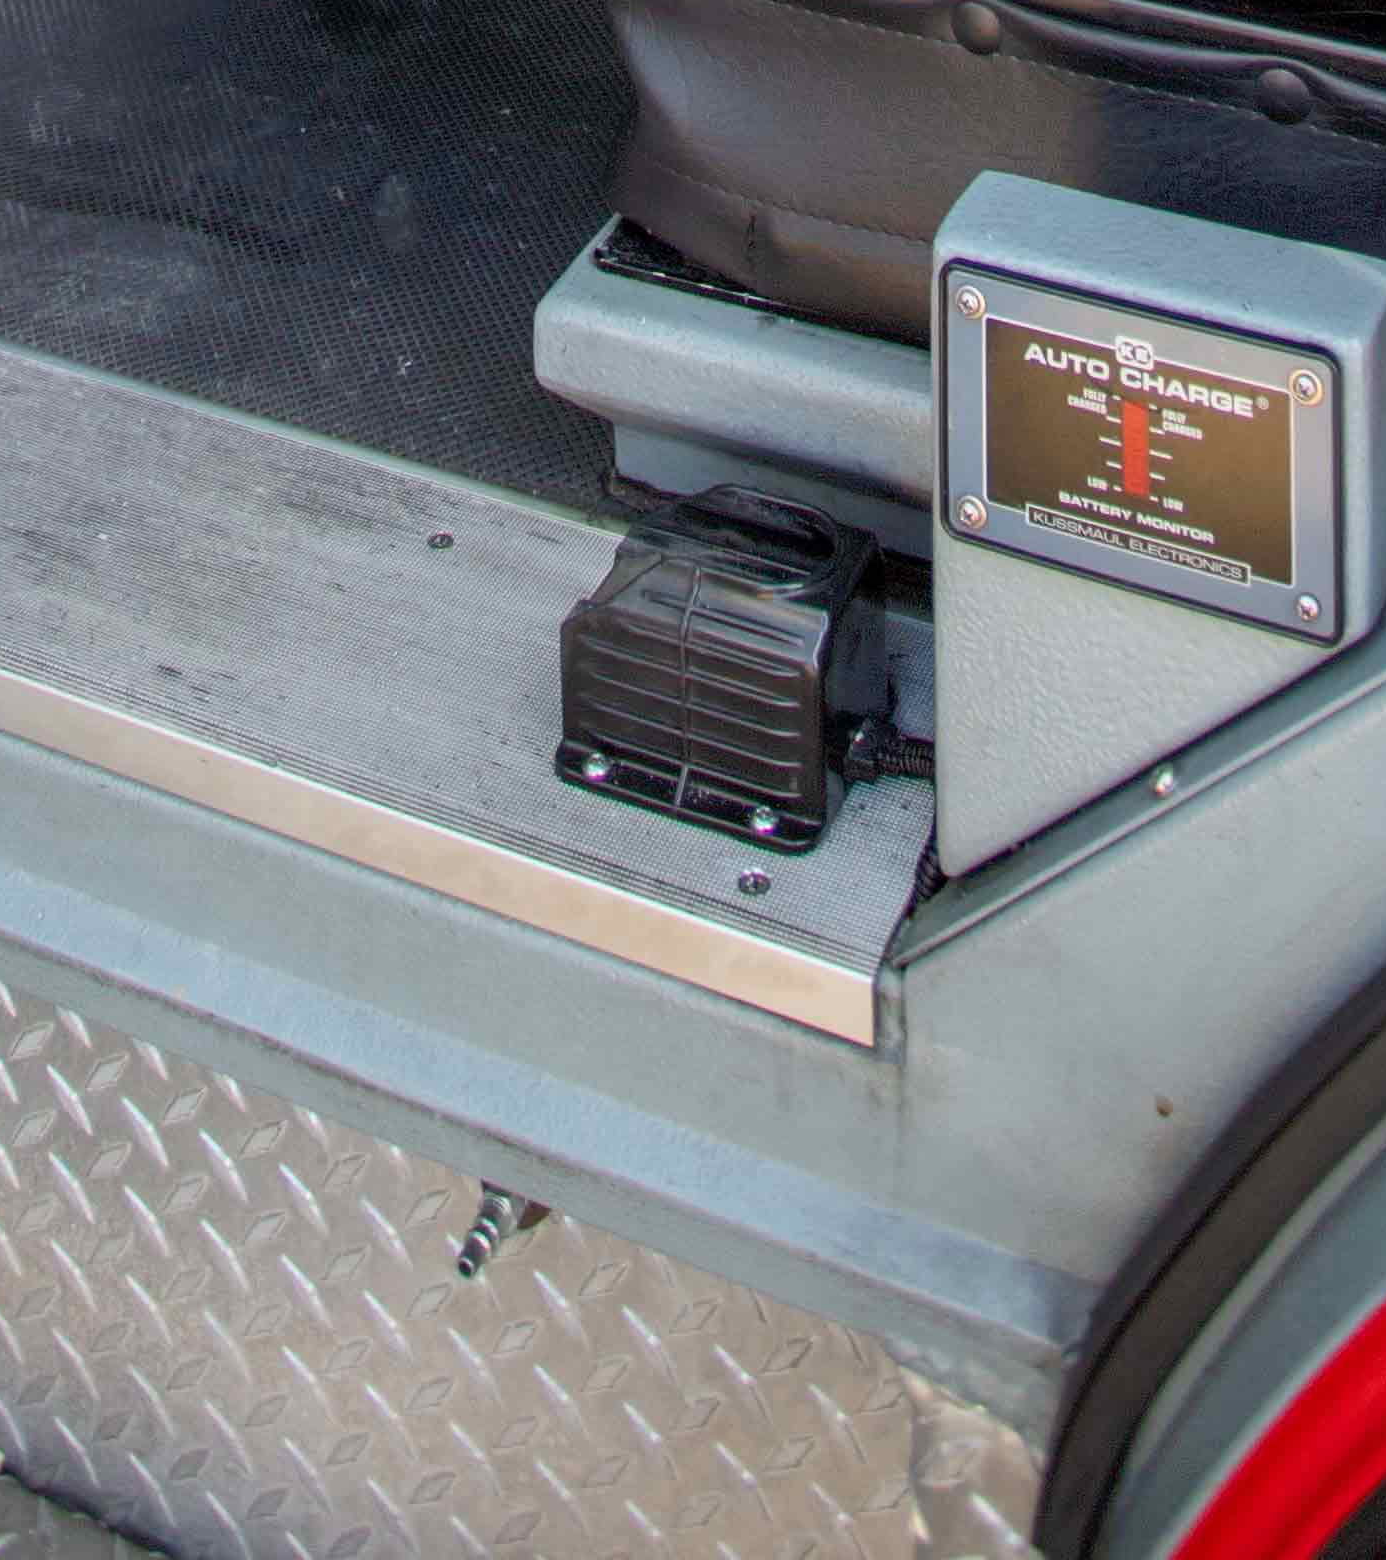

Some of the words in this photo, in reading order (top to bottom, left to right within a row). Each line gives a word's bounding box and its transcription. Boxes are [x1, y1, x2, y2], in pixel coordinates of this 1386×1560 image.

[1024, 344, 1110, 381] AUTO
[1119, 367, 1253, 418] CHARGE
[1083, 387, 1107, 403] FULLY
[1067, 395, 1107, 415] CHARGED
[1162, 409, 1187, 424] FULLY
[1162, 421, 1203, 440] CHARGED
[1087, 475, 1108, 491] LOW
[1163, 496, 1183, 512] LOW
[1059, 491, 1132, 521] BATTERY
[1136, 511, 1215, 544] MONITOR
[1033, 511, 1124, 546] KUSSMAUL
[1130, 538, 1243, 580] ELECTRONICS
